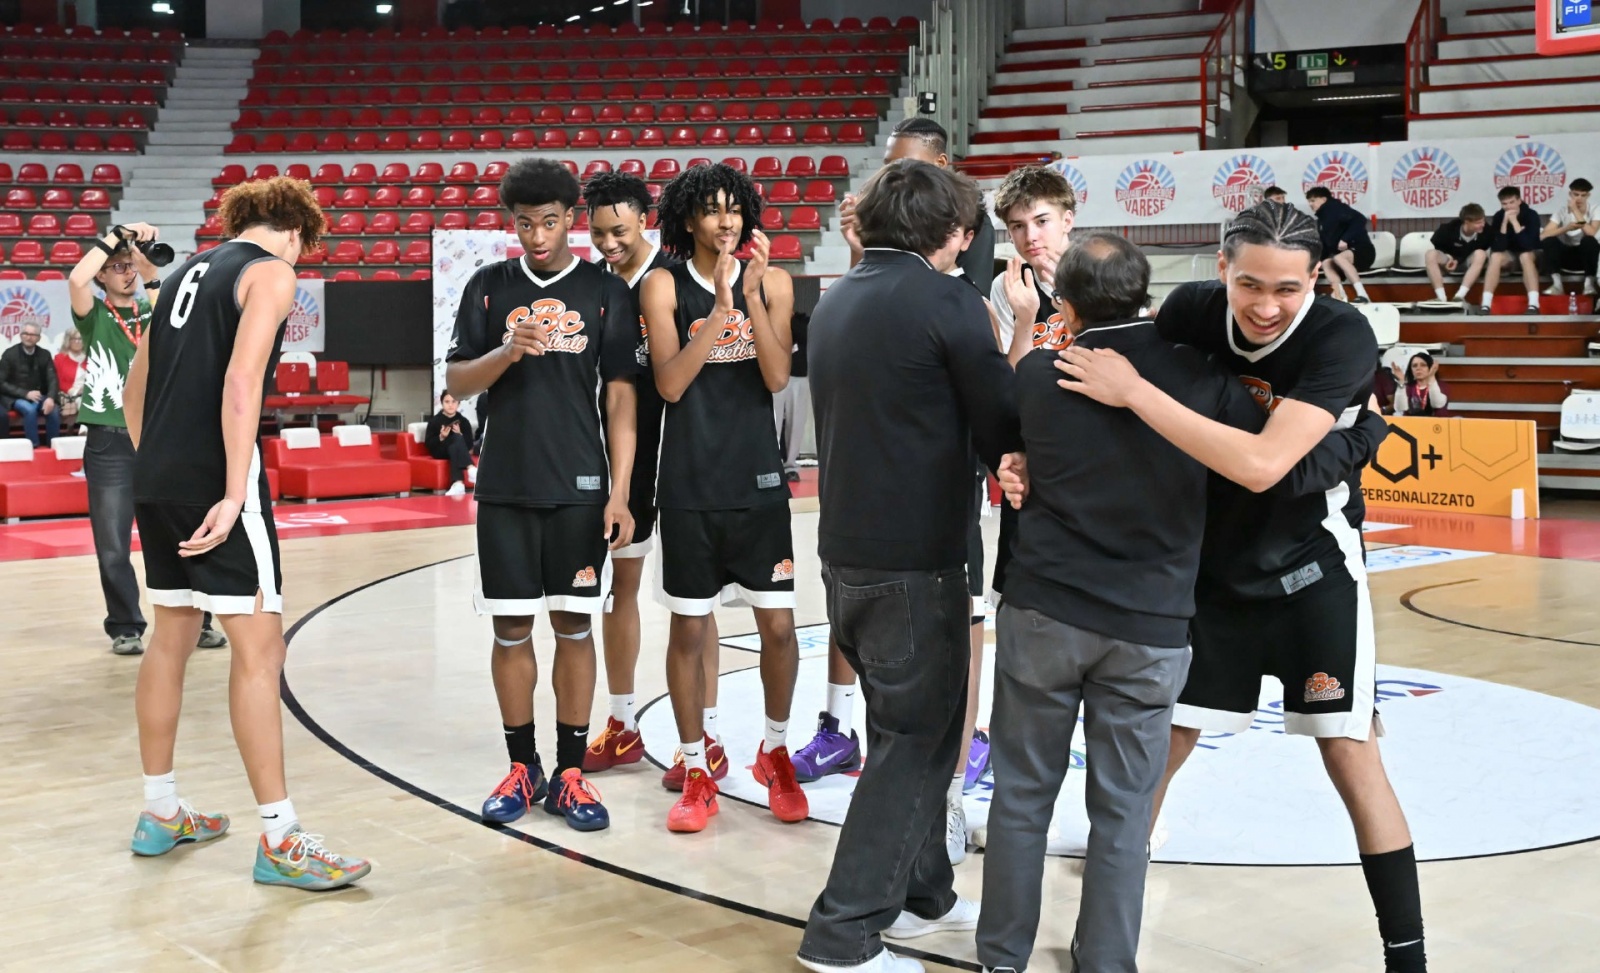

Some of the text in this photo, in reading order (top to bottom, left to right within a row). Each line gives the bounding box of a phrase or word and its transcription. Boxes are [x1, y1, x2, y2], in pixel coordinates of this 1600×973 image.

[1565, 4, 1588, 15] FIP
[1273, 54, 1287, 70] 5
[1402, 189, 1449, 208] VARESE
[1522, 185, 1554, 205] RESE
[1125, 198, 1165, 217] VARESE
[170, 262, 210, 329] 6
[505, 298, 585, 335] CBC
[284, 324, 311, 342] RESE
[291, 364, 297, 373] 2
[1361, 488, 1475, 508] PERSONALIZZATO
